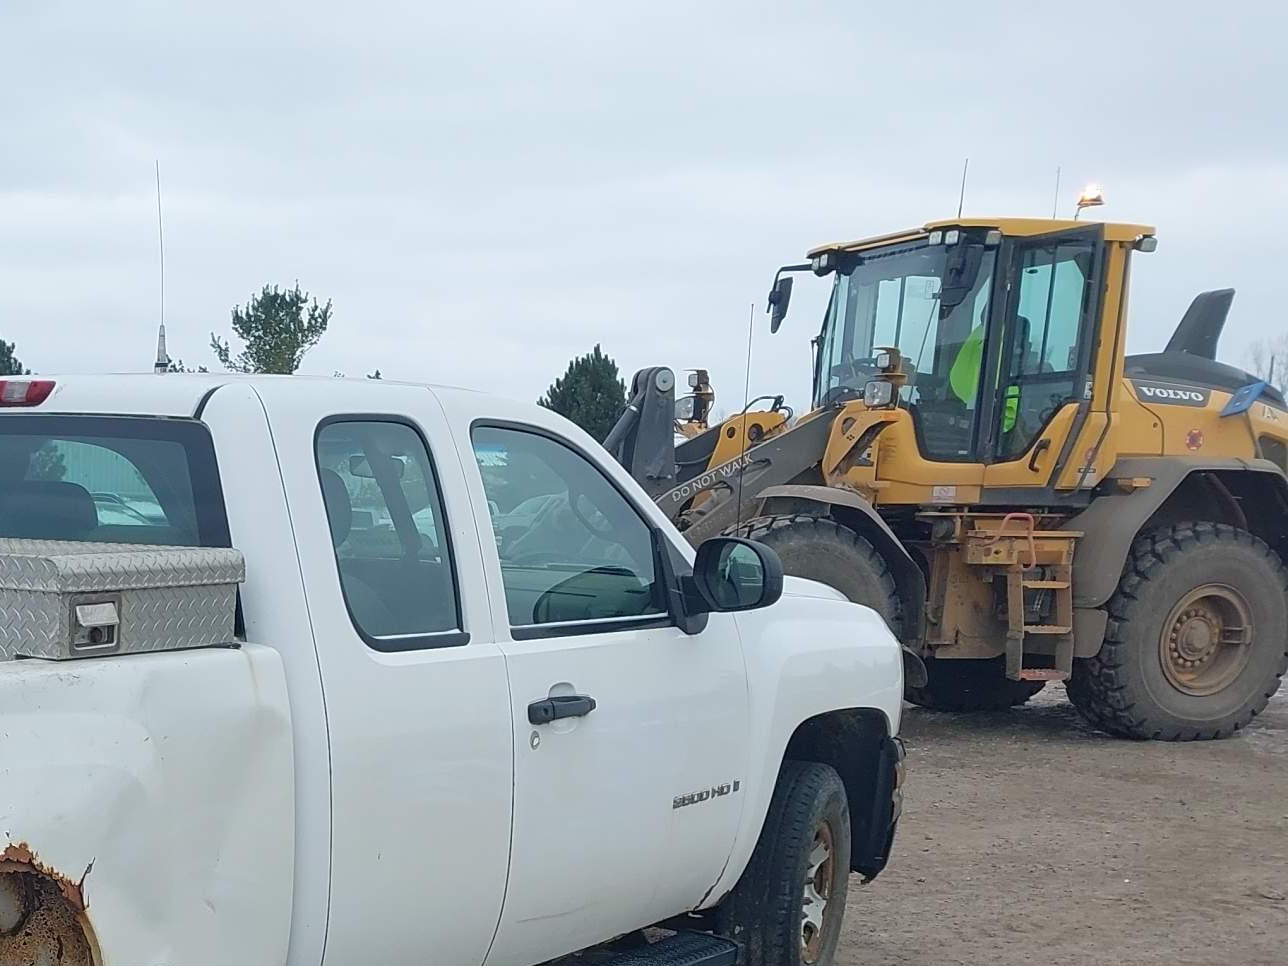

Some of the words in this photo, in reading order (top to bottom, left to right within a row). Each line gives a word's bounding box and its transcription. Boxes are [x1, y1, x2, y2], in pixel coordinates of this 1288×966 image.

[1139, 386, 1205, 402] VOLVO
[672, 486, 691, 502] DO
[692, 472, 717, 491] NOT
[719, 453, 753, 478] WALK
